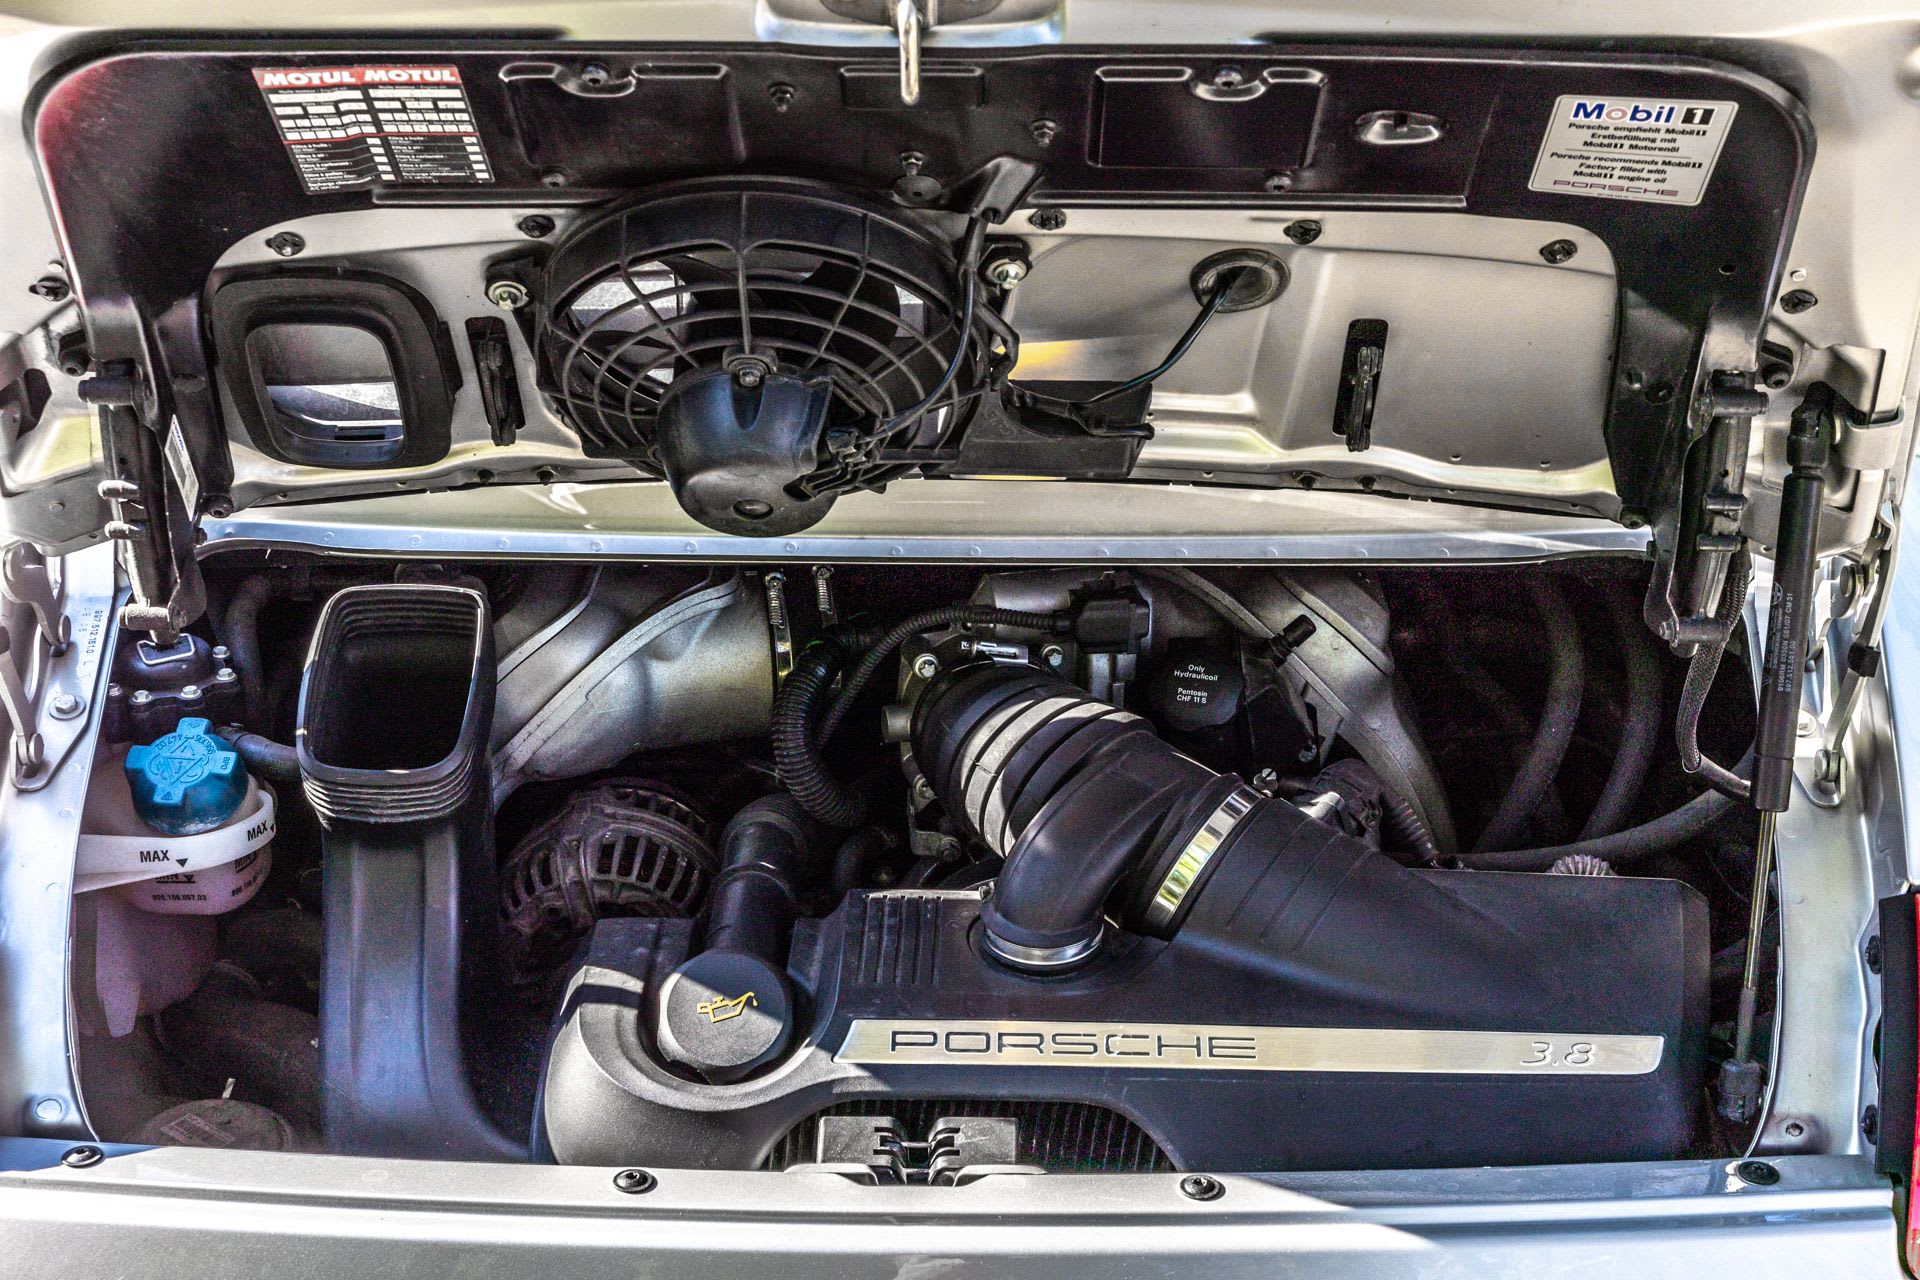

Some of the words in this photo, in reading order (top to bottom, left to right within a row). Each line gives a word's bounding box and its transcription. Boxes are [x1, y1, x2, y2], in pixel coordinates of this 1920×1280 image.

[263, 71, 356, 86] MOTUL
[364, 70, 457, 82] MOTUL
[1572, 102, 1676, 123] Mobil
[1686, 108, 1709, 125] 1
[1568, 122, 1610, 131] Porsche
[1613, 125, 1661, 133] empfiehlt
[1591, 132, 1657, 143] Erstbefüllung
[1628, 143, 1680, 152] Motorenöl
[1550, 152, 1591, 160] Porsche
[1594, 155, 1659, 165] recommends
[1579, 163, 1617, 171] Factory
[1553, 180, 1679, 197] PORSCHE
[1188, 664, 1205, 673] Only
[1174, 670, 1218, 681] Hydraulicoil
[1177, 687, 1208, 697] Pentosin
[247, 820, 268, 842] MAX
[139, 850, 170, 863] MAX
[890, 1030, 1257, 1060] PORSCHE
[1520, 1041, 1596, 1066] 3.8
